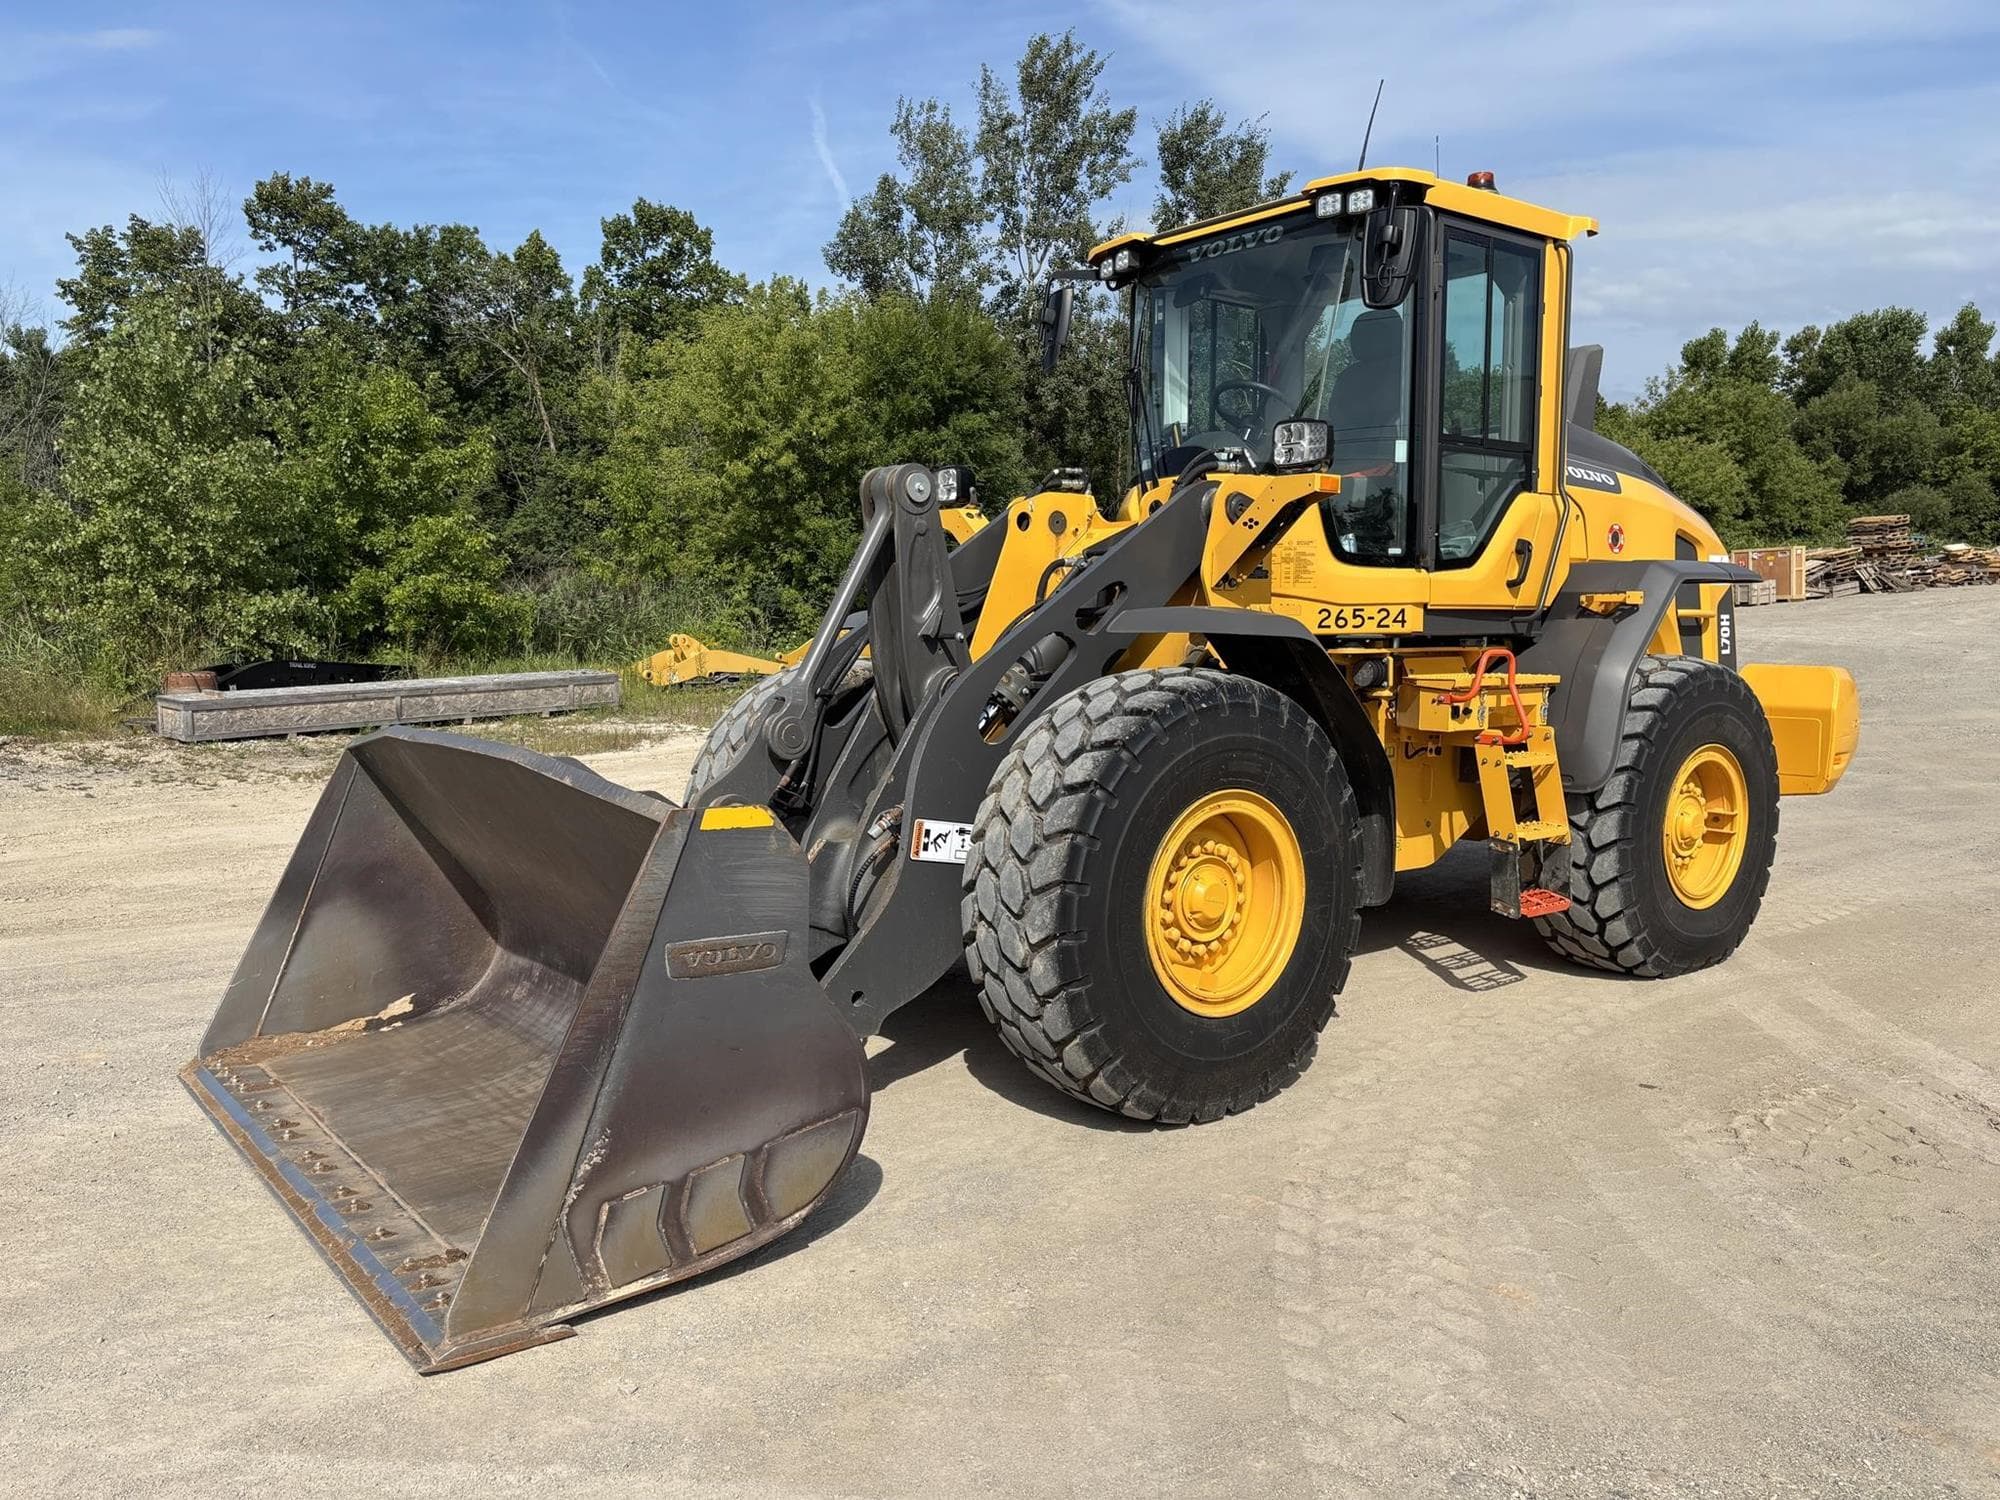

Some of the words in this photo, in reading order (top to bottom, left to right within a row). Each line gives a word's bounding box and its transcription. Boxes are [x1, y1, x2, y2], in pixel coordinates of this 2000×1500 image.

[1187, 225, 1284, 263] VOLVO
[1565, 466, 1615, 486] OLVO
[1317, 608, 1407, 629] 265-24
[1720, 614, 1731, 655] L70H
[679, 942, 777, 968] VOLVO
